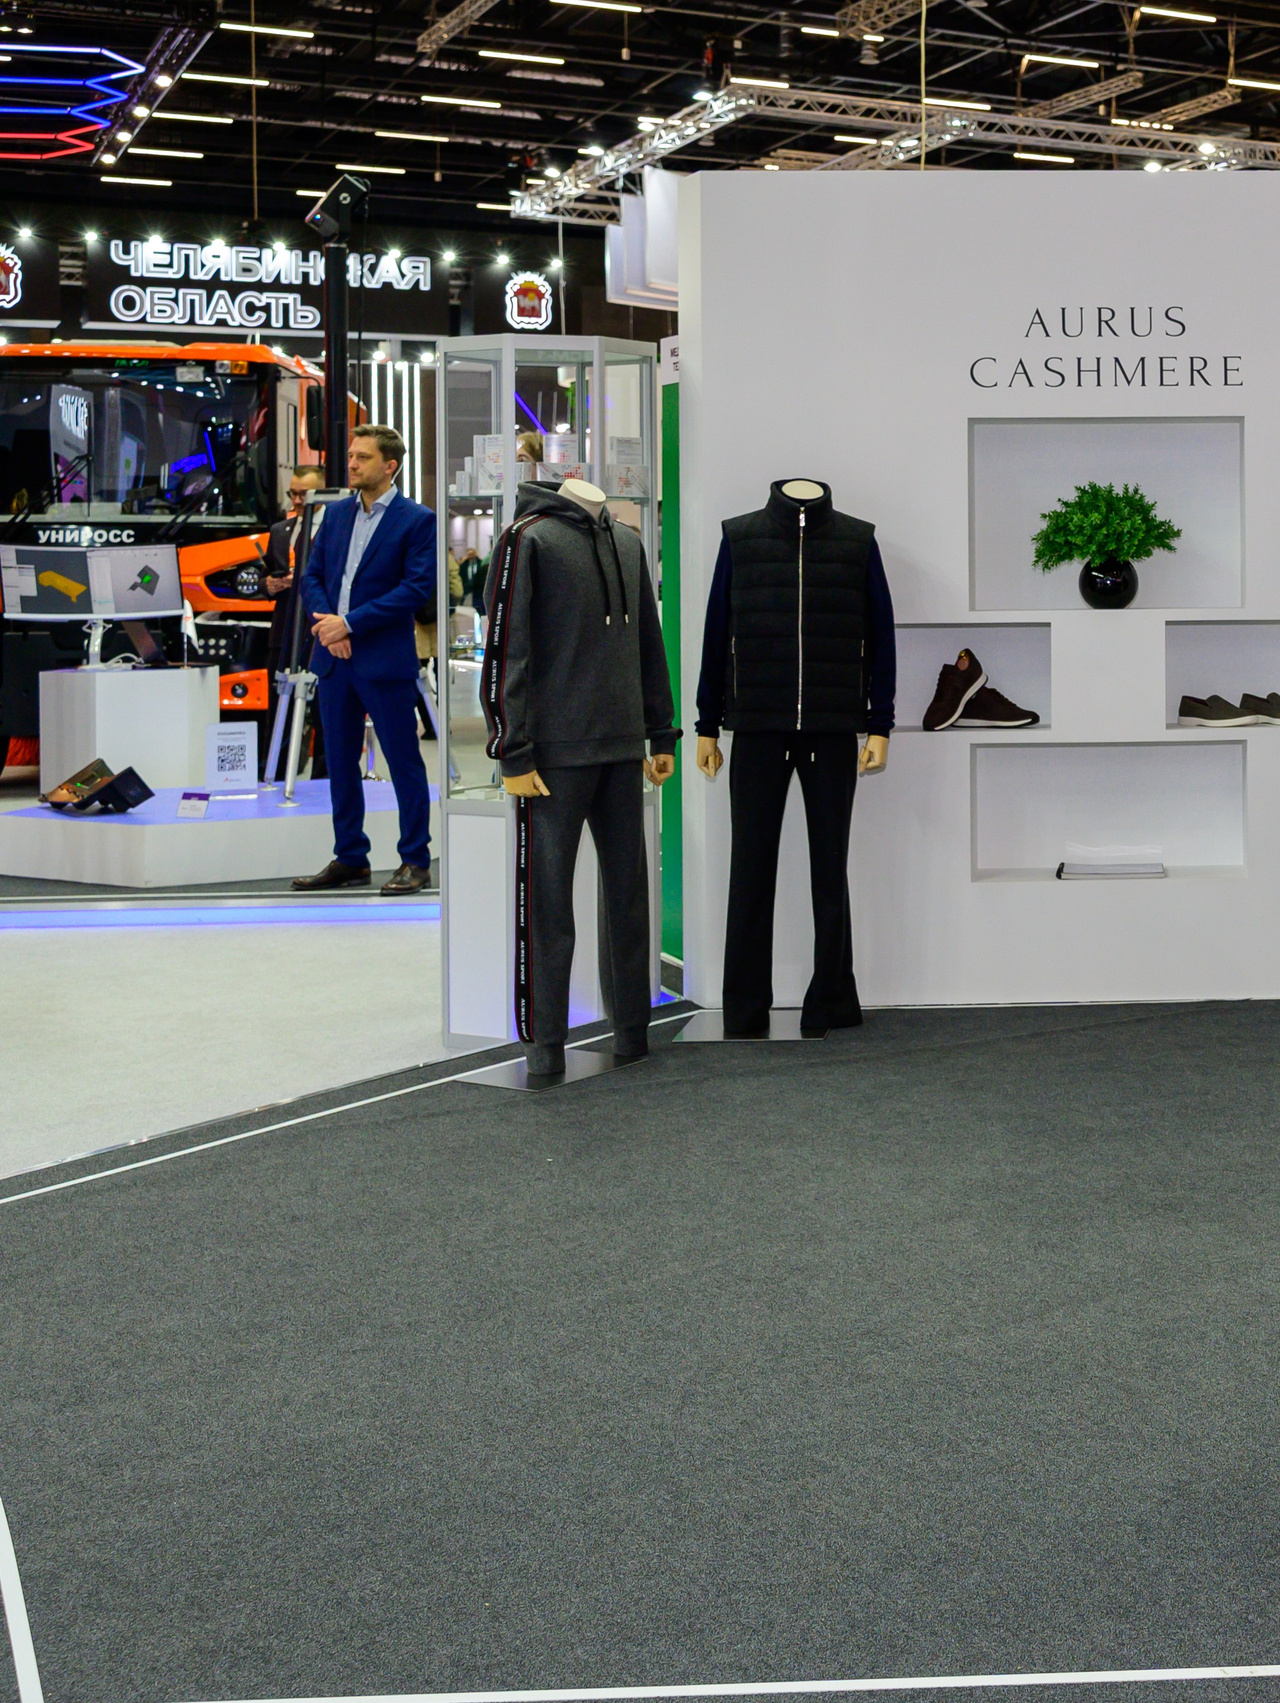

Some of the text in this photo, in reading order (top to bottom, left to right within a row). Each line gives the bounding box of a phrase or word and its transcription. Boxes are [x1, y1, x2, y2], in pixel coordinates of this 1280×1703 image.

[110, 239, 431, 290] ЧЕЛЯБИНКАЯ
[110, 284, 321, 329] ОБЛАСТЬ
[1024, 306, 1187, 338] AURUS
[969, 356, 1244, 388] CASHMERE
[38, 529, 135, 544] УНИРОСС
